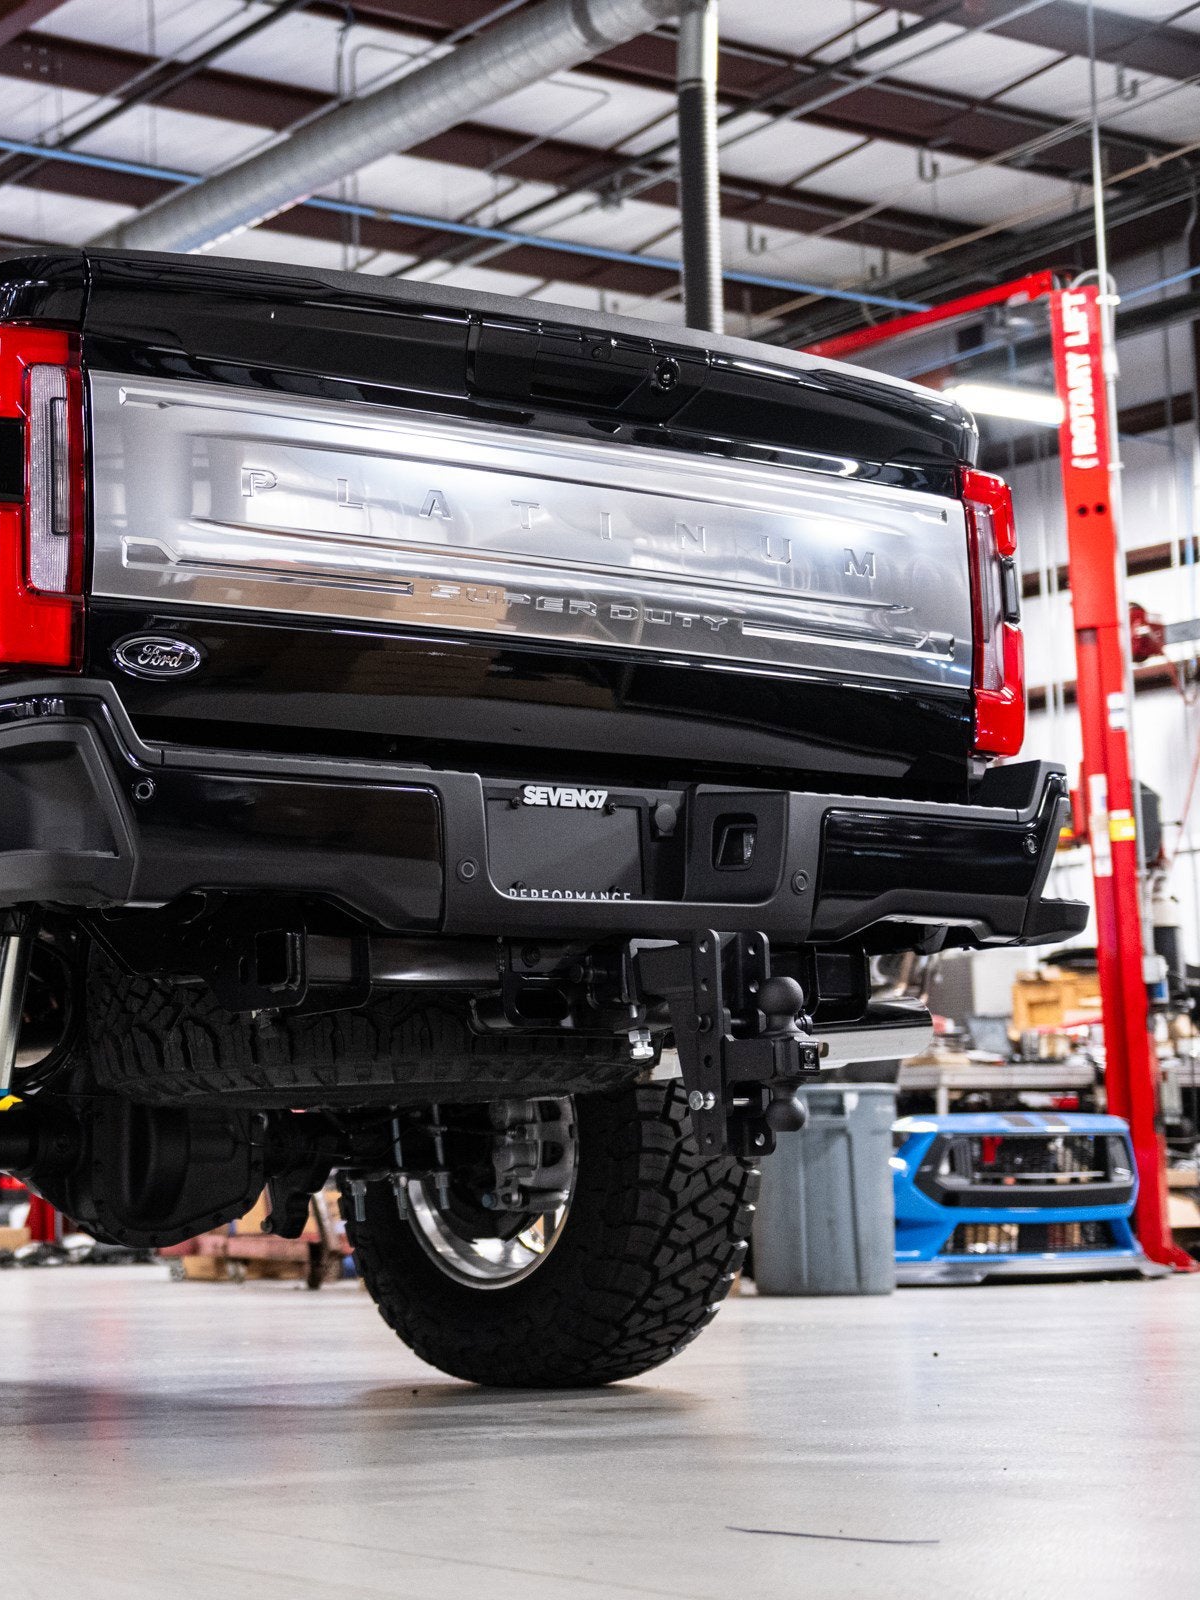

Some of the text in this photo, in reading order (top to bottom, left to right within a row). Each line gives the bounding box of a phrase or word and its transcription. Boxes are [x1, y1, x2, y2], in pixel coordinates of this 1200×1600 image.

[1061, 291, 1098, 457] ROTARY LIFT
[241, 467, 876, 578] PLATINUM
[430, 584, 728, 632] SUPER DUTY
[137, 643, 183, 668] Ford
[508, 888, 631, 901] PERFORMANCE
